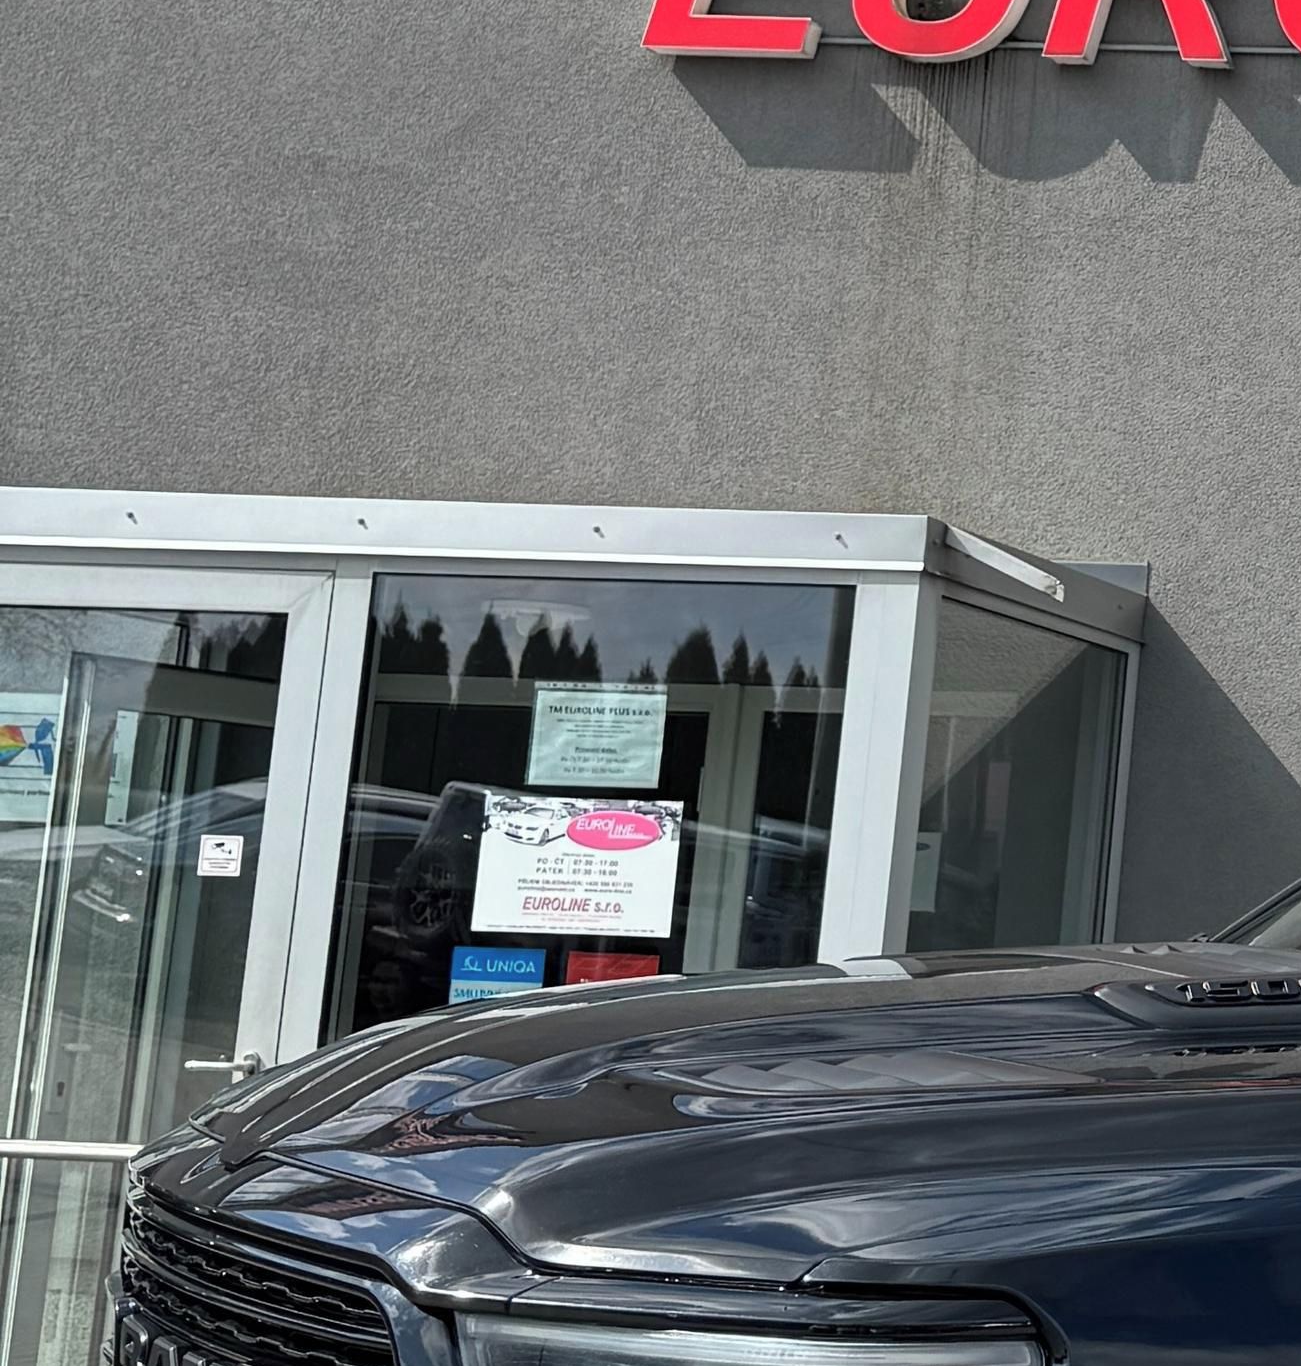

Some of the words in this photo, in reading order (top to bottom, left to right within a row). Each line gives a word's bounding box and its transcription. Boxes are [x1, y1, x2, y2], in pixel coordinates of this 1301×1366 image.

[564, 705, 607, 715] EUROLINE
[522, 896, 592, 912] EUROLINE
[594, 900, 624, 914] s.r.o.
[486, 959, 536, 973] UNIQA
